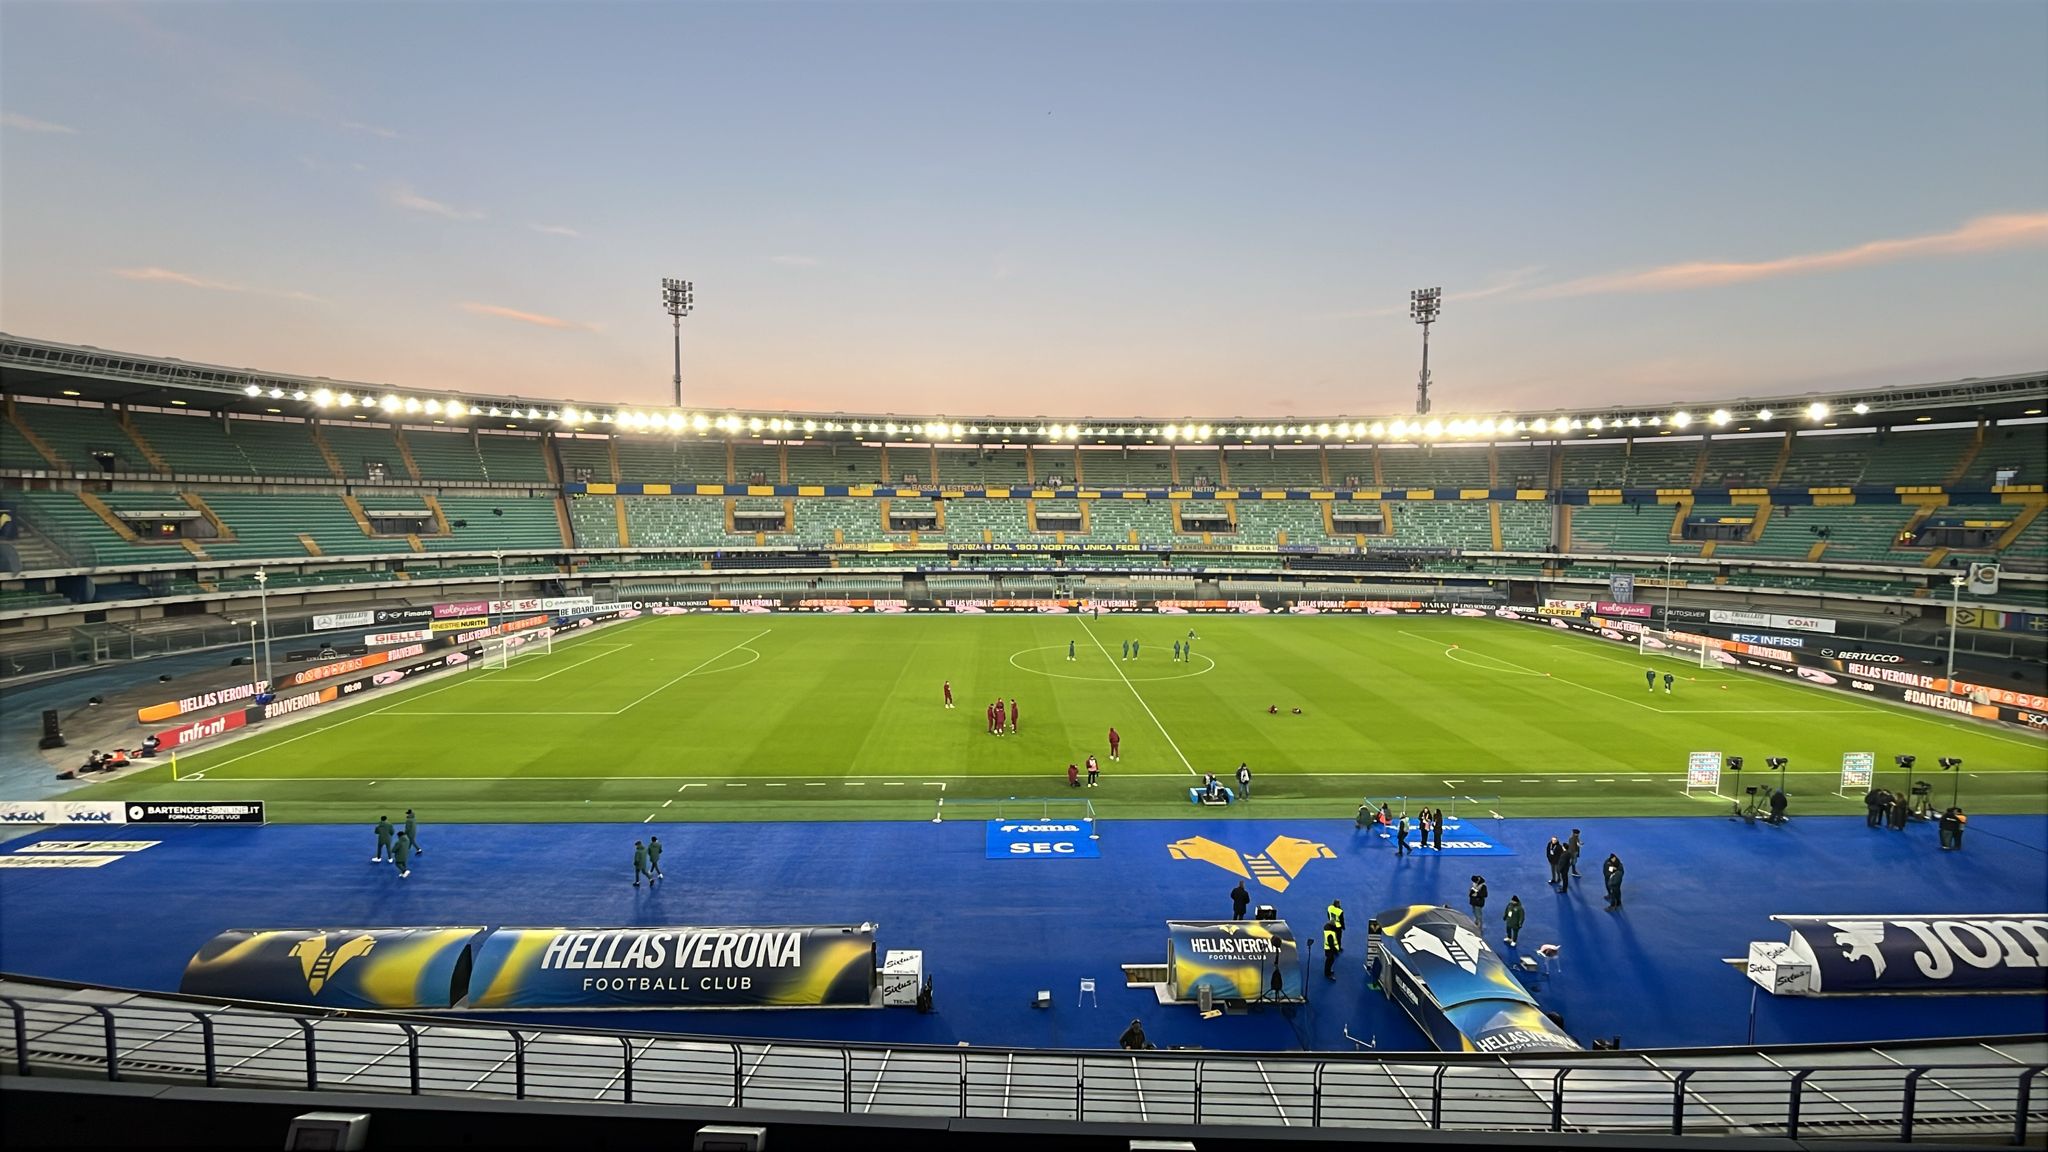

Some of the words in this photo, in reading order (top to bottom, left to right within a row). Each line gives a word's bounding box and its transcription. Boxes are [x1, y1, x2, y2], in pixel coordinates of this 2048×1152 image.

[520, 599, 538, 609] SEC
[404, 610, 432, 618] Fimauto
[560, 608, 570, 616] BE
[572, 606, 594, 614] BOARD
[460, 620, 486, 628] NURITH
[1787, 619, 1818, 628] COATI
[375, 630, 424, 642] GIELLE
[1741, 634, 1758, 644] SZ
[1760, 635, 1803, 648] INFISSI
[1838, 651, 1900, 663] BERTUCCO
[1848, 663, 1881, 679] HELLAS
[1882, 668, 1919, 687] VERONA
[1920, 676, 1934, 689] FC
[344, 681, 362, 694] 00:00
[1851, 680, 1875, 692] 00:00
[179, 692, 217, 714] HELLAS
[216, 683, 255, 704] VERONA
[264, 691, 320, 719] #DAIVERONA
[1904, 689, 1973, 716] #DAIVERONA
[1010, 842, 1075, 854] SEC
[541, 932, 673, 970] HELLAS
[674, 932, 801, 970] VERONA
[1191, 938, 1236, 953] HELLAS
[583, 976, 690, 991] FOOTBALL
[700, 976, 752, 991] CLUB
[884, 979, 912, 997] Sixtus
[1476, 1030, 1525, 1052] HELLAS
